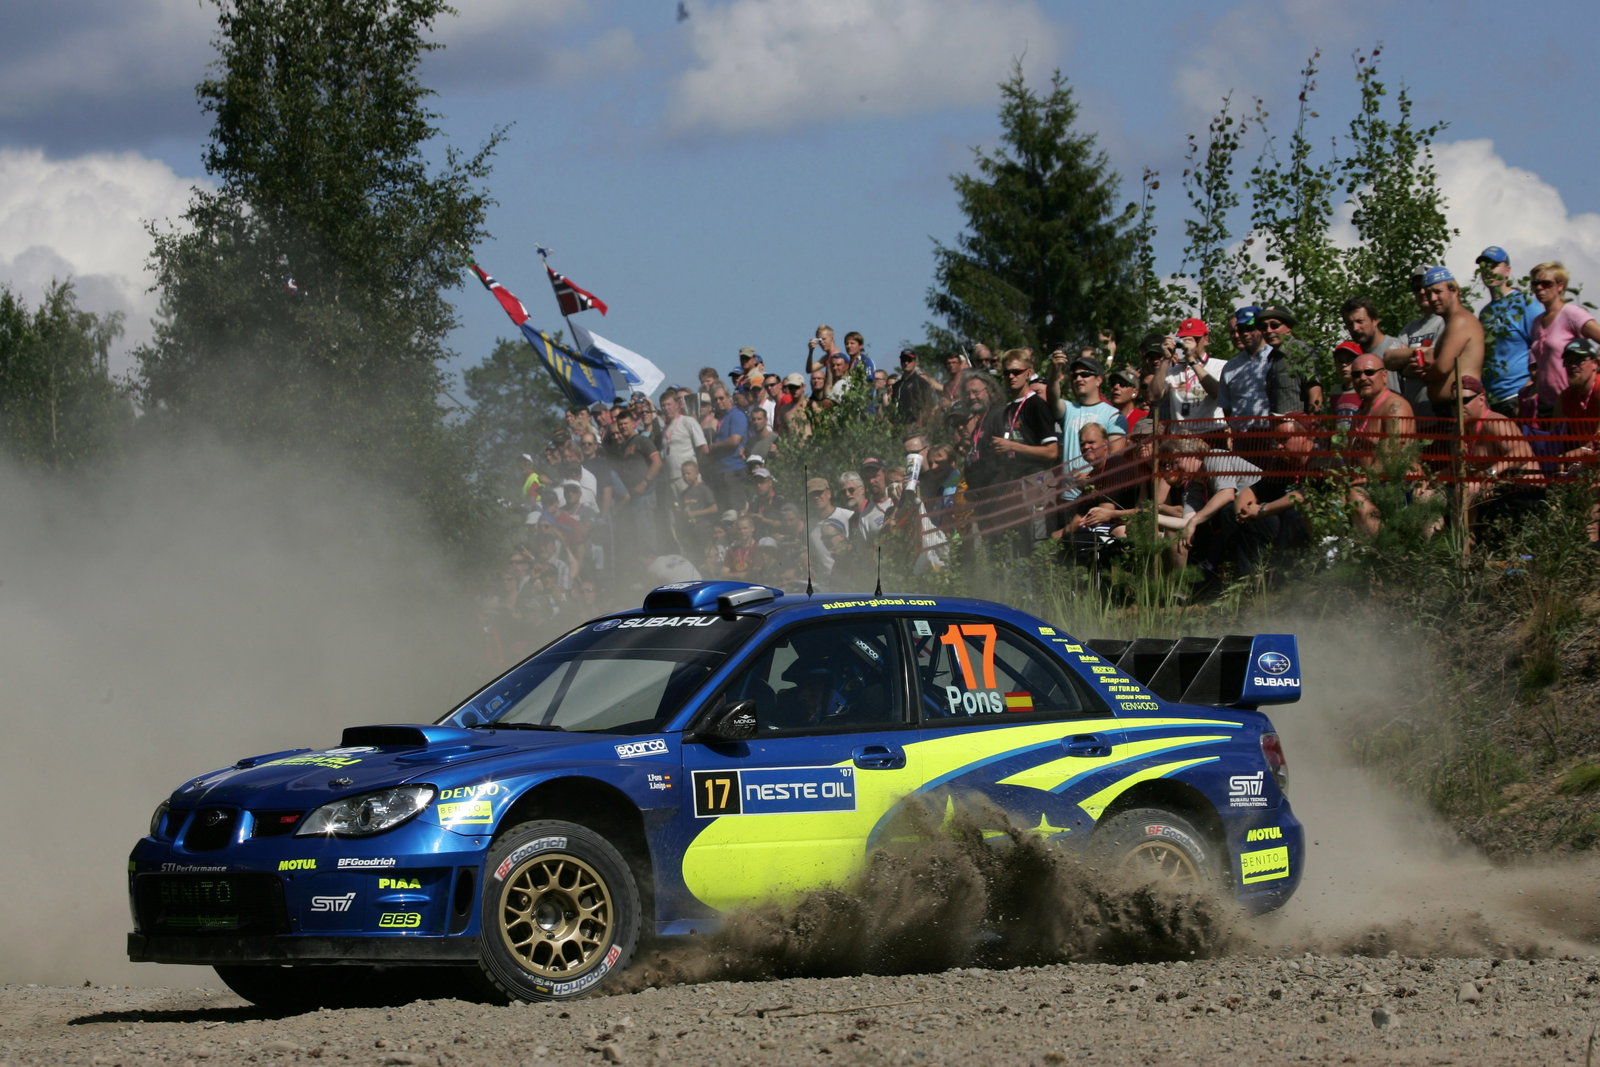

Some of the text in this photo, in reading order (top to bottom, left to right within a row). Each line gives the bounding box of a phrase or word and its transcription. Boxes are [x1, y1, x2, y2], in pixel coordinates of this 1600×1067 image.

[822, 598, 937, 610] subaru-global.com
[618, 616, 719, 629] SUBARU
[940, 624, 997, 690] 17
[1254, 677, 1300, 687] SUBARU
[945, 686, 1003, 714] Pons
[1121, 702, 1158, 710] KENWOOD
[617, 741, 665, 757] sparco
[840, 769, 852, 777] '07
[440, 784, 500, 800] DENSO
[705, 779, 731, 809] 17
[746, 782, 852, 801] NESTE OIL
[1247, 827, 1283, 842] MOTUL
[278, 859, 317, 871] MOTUL
[337, 858, 396, 868] BFGoodrich
[498, 837, 567, 879] BFGoodrich
[1243, 853, 1279, 868] BENITO
[161, 863, 176, 872] STI
[379, 879, 422, 889] PIAA
[380, 913, 421, 927] BBS
[554, 945, 621, 994] BFGoodrich
